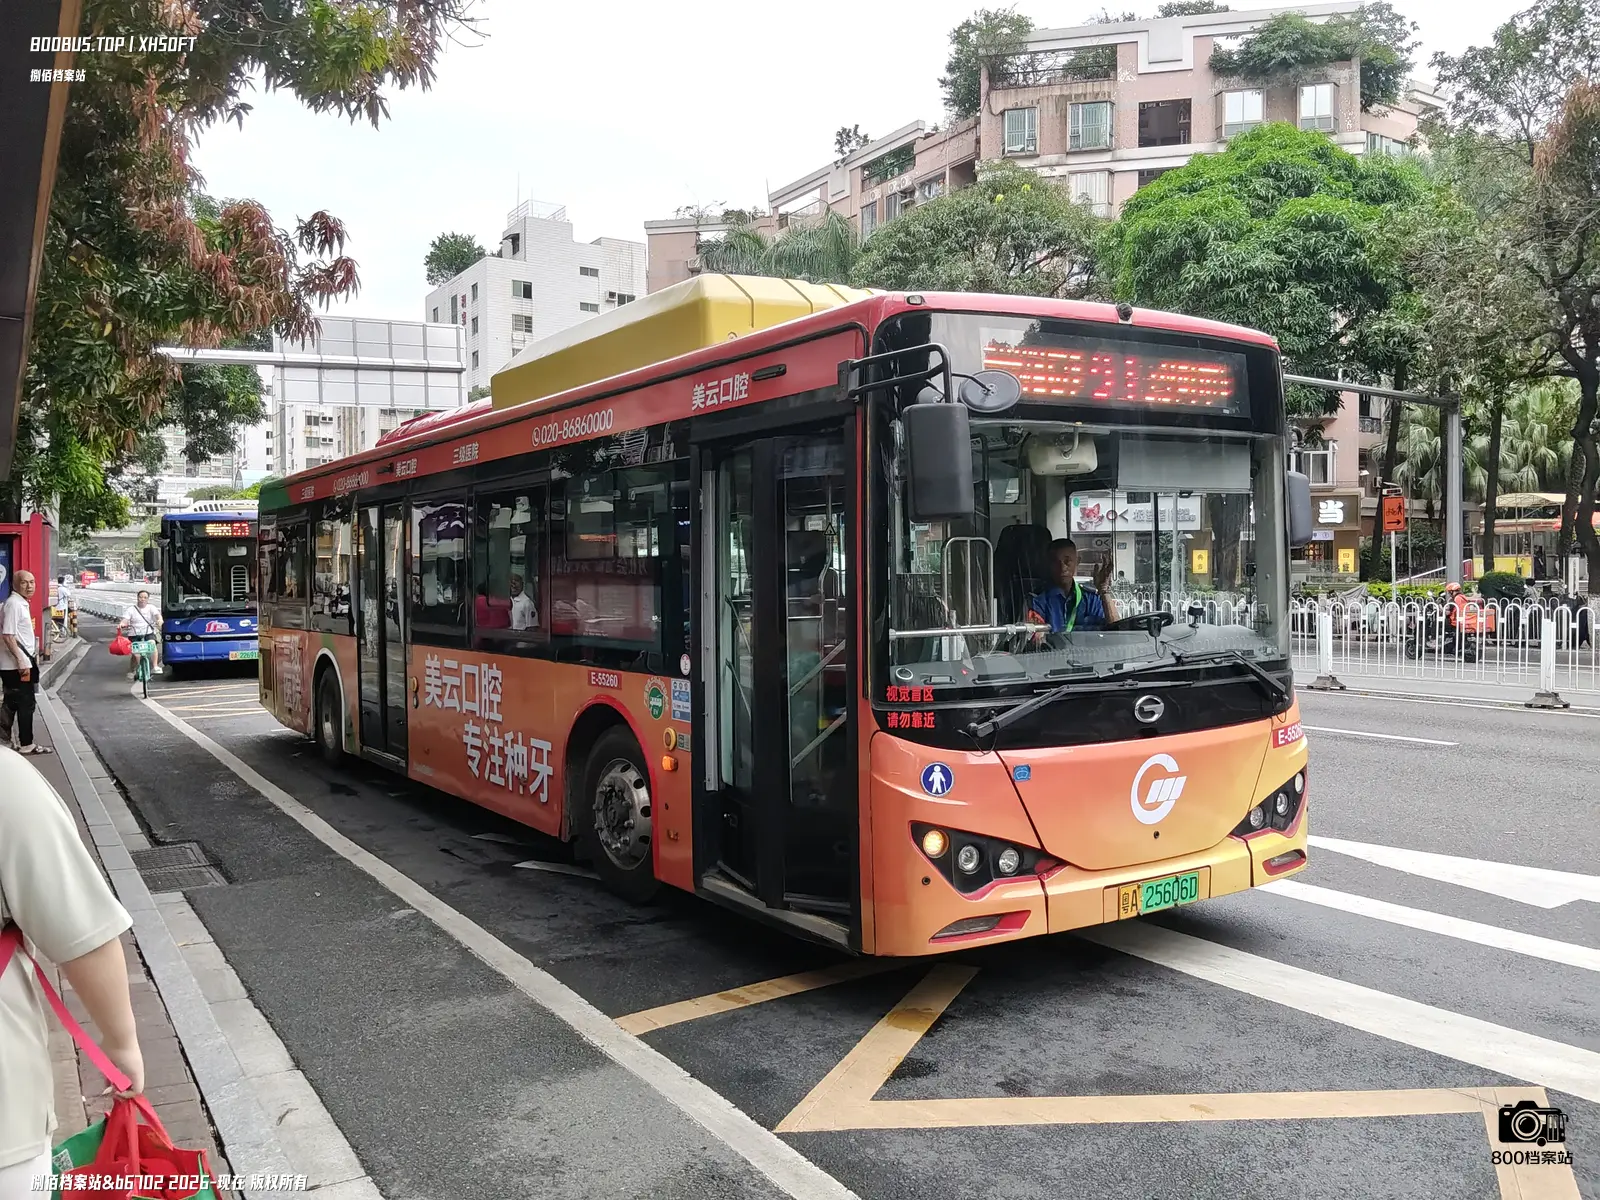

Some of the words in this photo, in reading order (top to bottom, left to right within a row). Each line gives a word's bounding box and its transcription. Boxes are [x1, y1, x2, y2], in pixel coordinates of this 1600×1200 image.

[691, 372, 749, 410] 美云口腔
[541, 408, 613, 445] 020-86860000
[1318, 500, 1344, 524] 当
[425, 653, 503, 722] 美云口腔
[591, 672, 618, 687] E-55260
[886, 685, 934, 702] 视觉盲区
[887, 711, 936, 728] 请勿靠近
[463, 719, 553, 803] 专注种牙
[1145, 876, 1197, 909] 25606D
